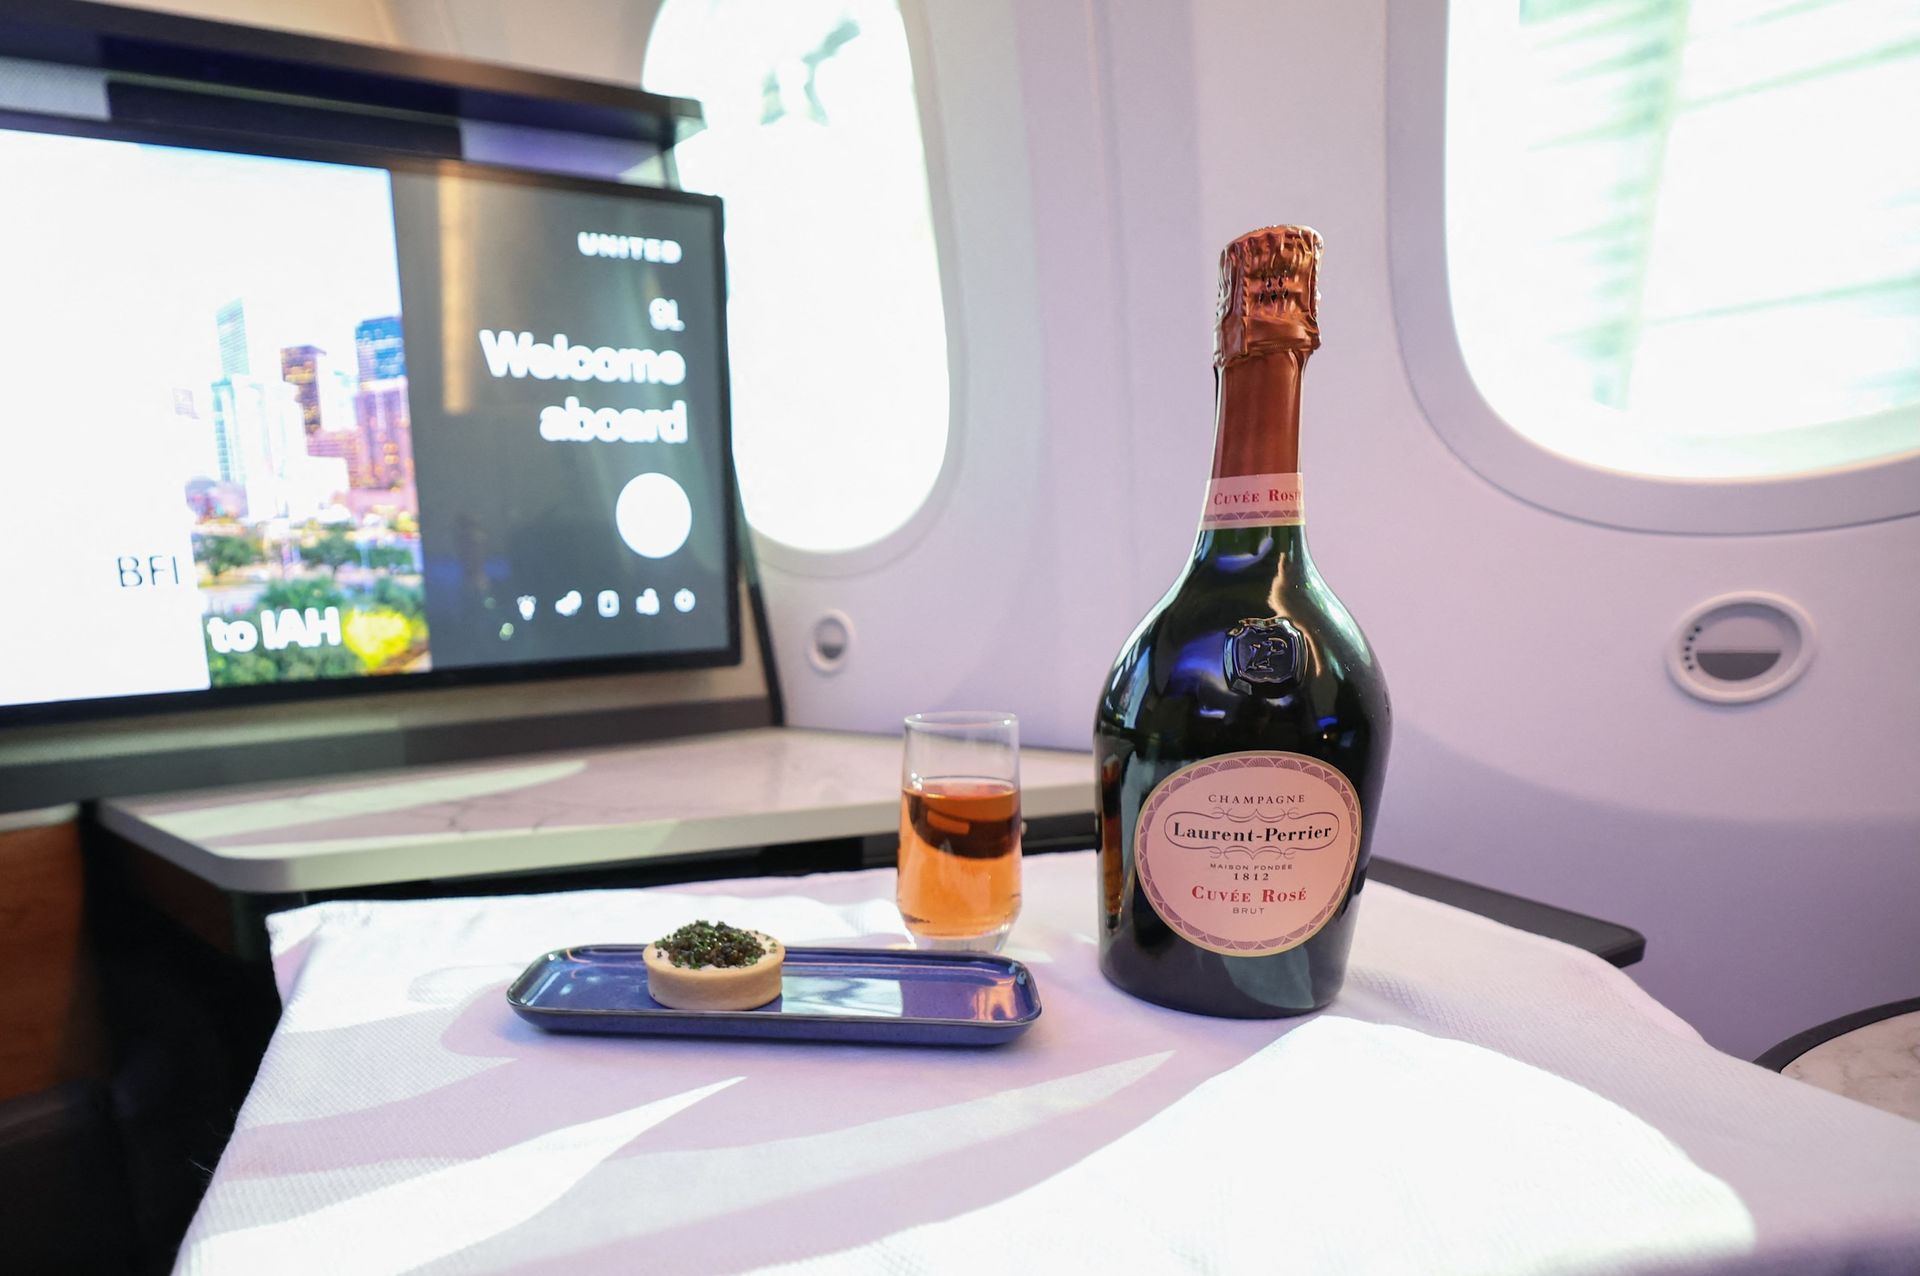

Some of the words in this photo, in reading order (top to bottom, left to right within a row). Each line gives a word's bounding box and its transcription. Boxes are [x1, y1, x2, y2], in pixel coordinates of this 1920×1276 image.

[577, 231, 682, 264] UNITED
[479, 329, 686, 385] Welcome
[539, 396, 688, 443] aboard
[117, 555, 180, 588] BFI
[206, 617, 258, 653] to
[260, 606, 342, 650] IAH
[1208, 794, 1306, 805] CHAMPAGNE
[1174, 822, 1332, 843] Laurent-Perrier
[1210, 863, 1250, 871] MAISON
[1254, 863, 1293, 871] FONDÉE
[1233, 872, 1270, 882] 1812
[1232, 907, 1265, 915] BRUT
